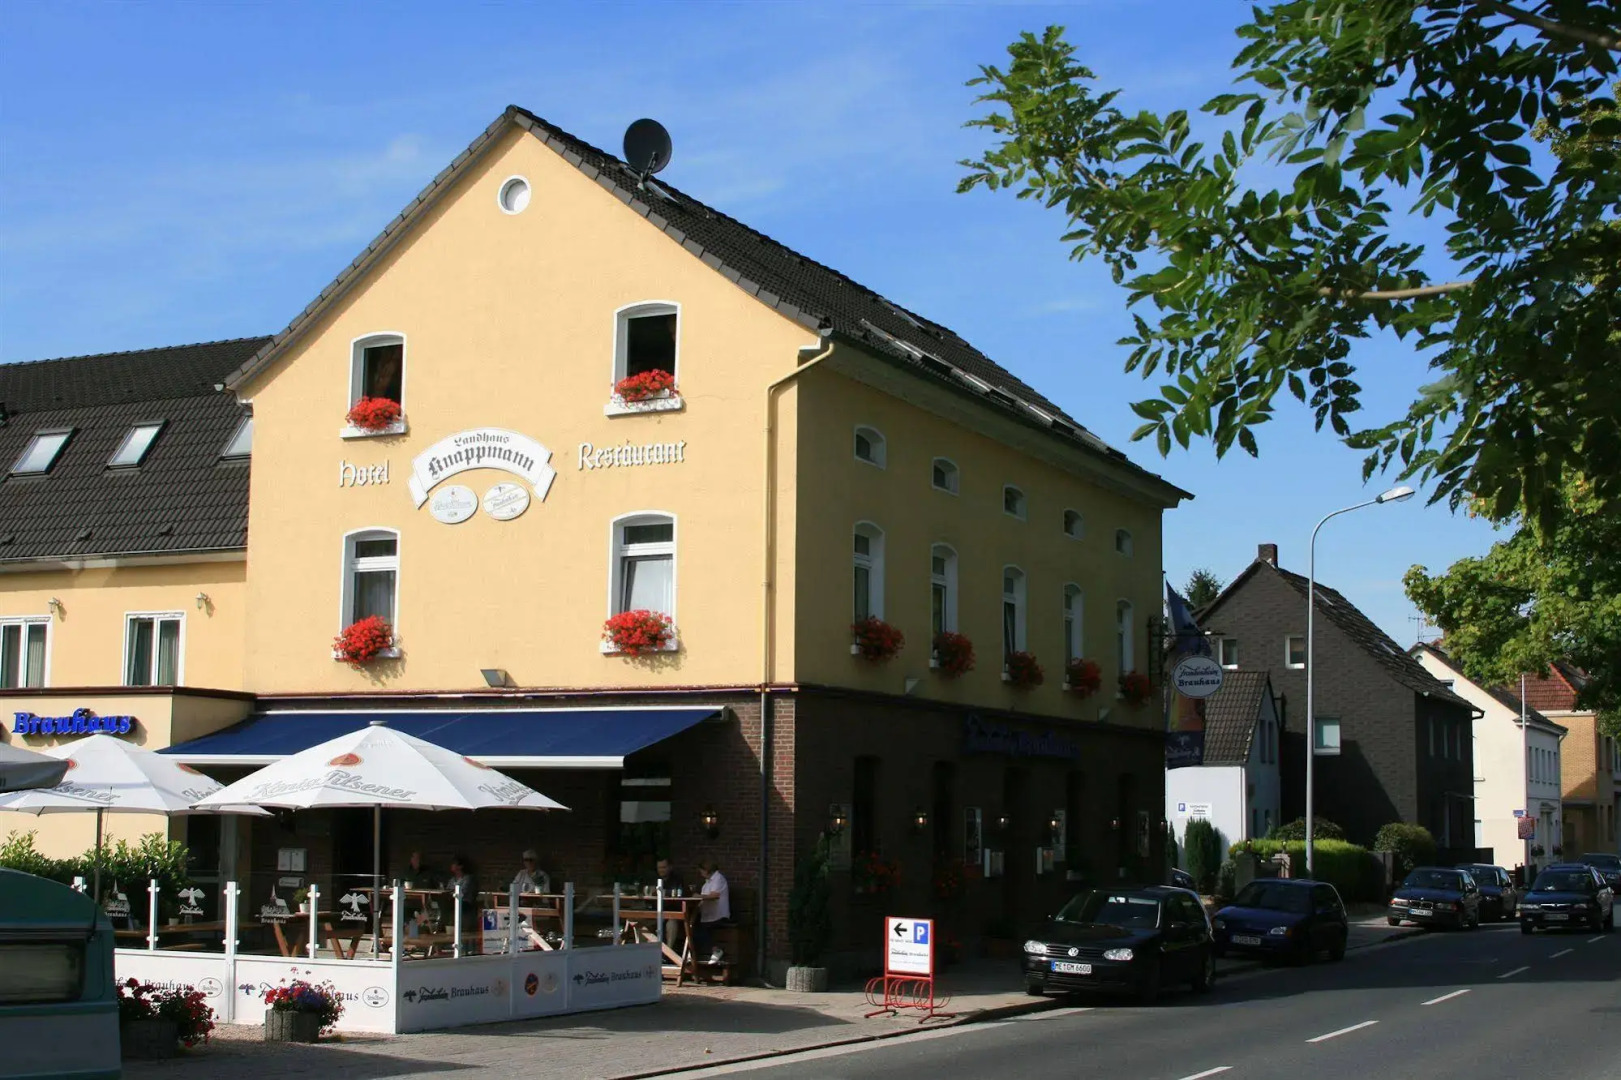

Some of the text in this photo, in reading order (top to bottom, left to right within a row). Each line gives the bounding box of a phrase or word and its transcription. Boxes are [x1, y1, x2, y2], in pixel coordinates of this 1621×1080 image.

[454, 432, 511, 447] Landhaus
[428, 445, 535, 481] Knappmann
[578, 441, 687, 471] Restaurant
[339, 459, 390, 487] Hotel
[1178, 678, 1220, 687] Brauhaus
[12, 707, 132, 735] Brauhaus
[323, 769, 418, 802] Pilsener
[917, 925, 925, 940] P
[450, 985, 489, 999] Brauhaus
